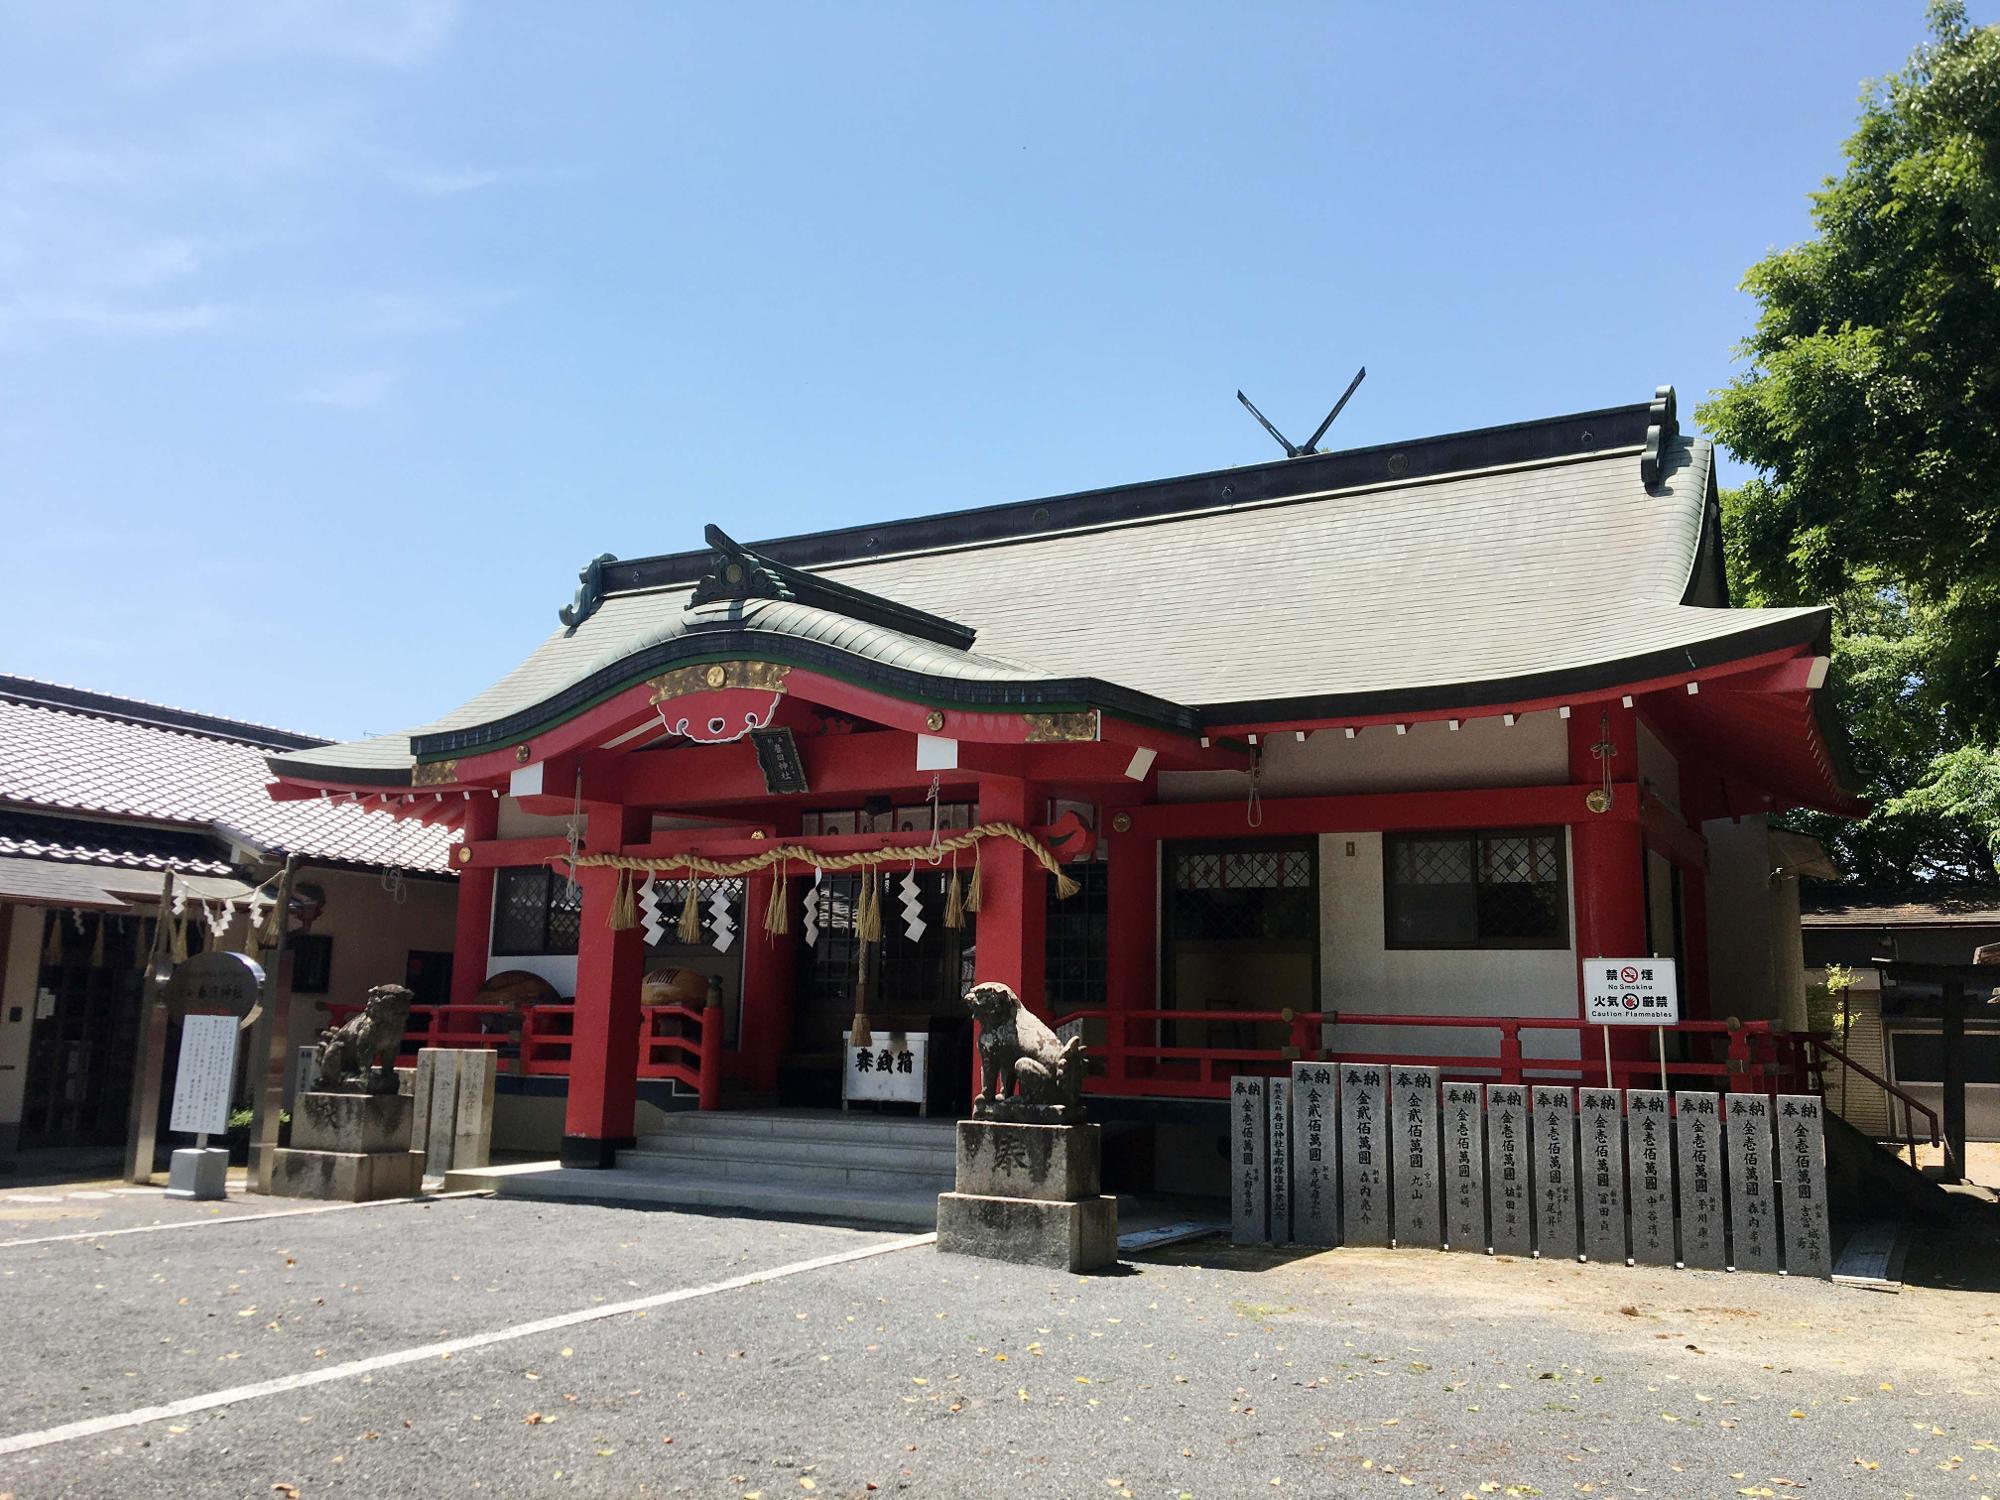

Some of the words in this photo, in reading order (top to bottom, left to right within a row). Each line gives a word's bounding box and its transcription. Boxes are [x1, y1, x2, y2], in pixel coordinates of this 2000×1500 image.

[1606, 969, 1618, 981] 禁
[1641, 969, 1654, 981] 煙
[1594, 995, 1619, 1008] 火気
[1642, 995, 1669, 1008] 厳禁
[1297, 1067, 1330, 1086] 奉納
[1346, 1069, 1380, 1088] 奉納
[1396, 1072, 1431, 1090] 奉納
[1234, 1081, 1261, 1097] 奉納
[1447, 1089, 1477, 1105] 奉納
[1492, 1091, 1521, 1107] 奉納
[1537, 1091, 1568, 1109] 奉納
[1584, 1095, 1616, 1111] 奉納
[1631, 1096, 1664, 1113] 奉納
[1680, 1098, 1714, 1115] 奉納
[1731, 1100, 1765, 1117] 奉納
[1782, 1101, 1817, 1119] 奉納
[1410, 1174, 1424, 1201] 丸山
